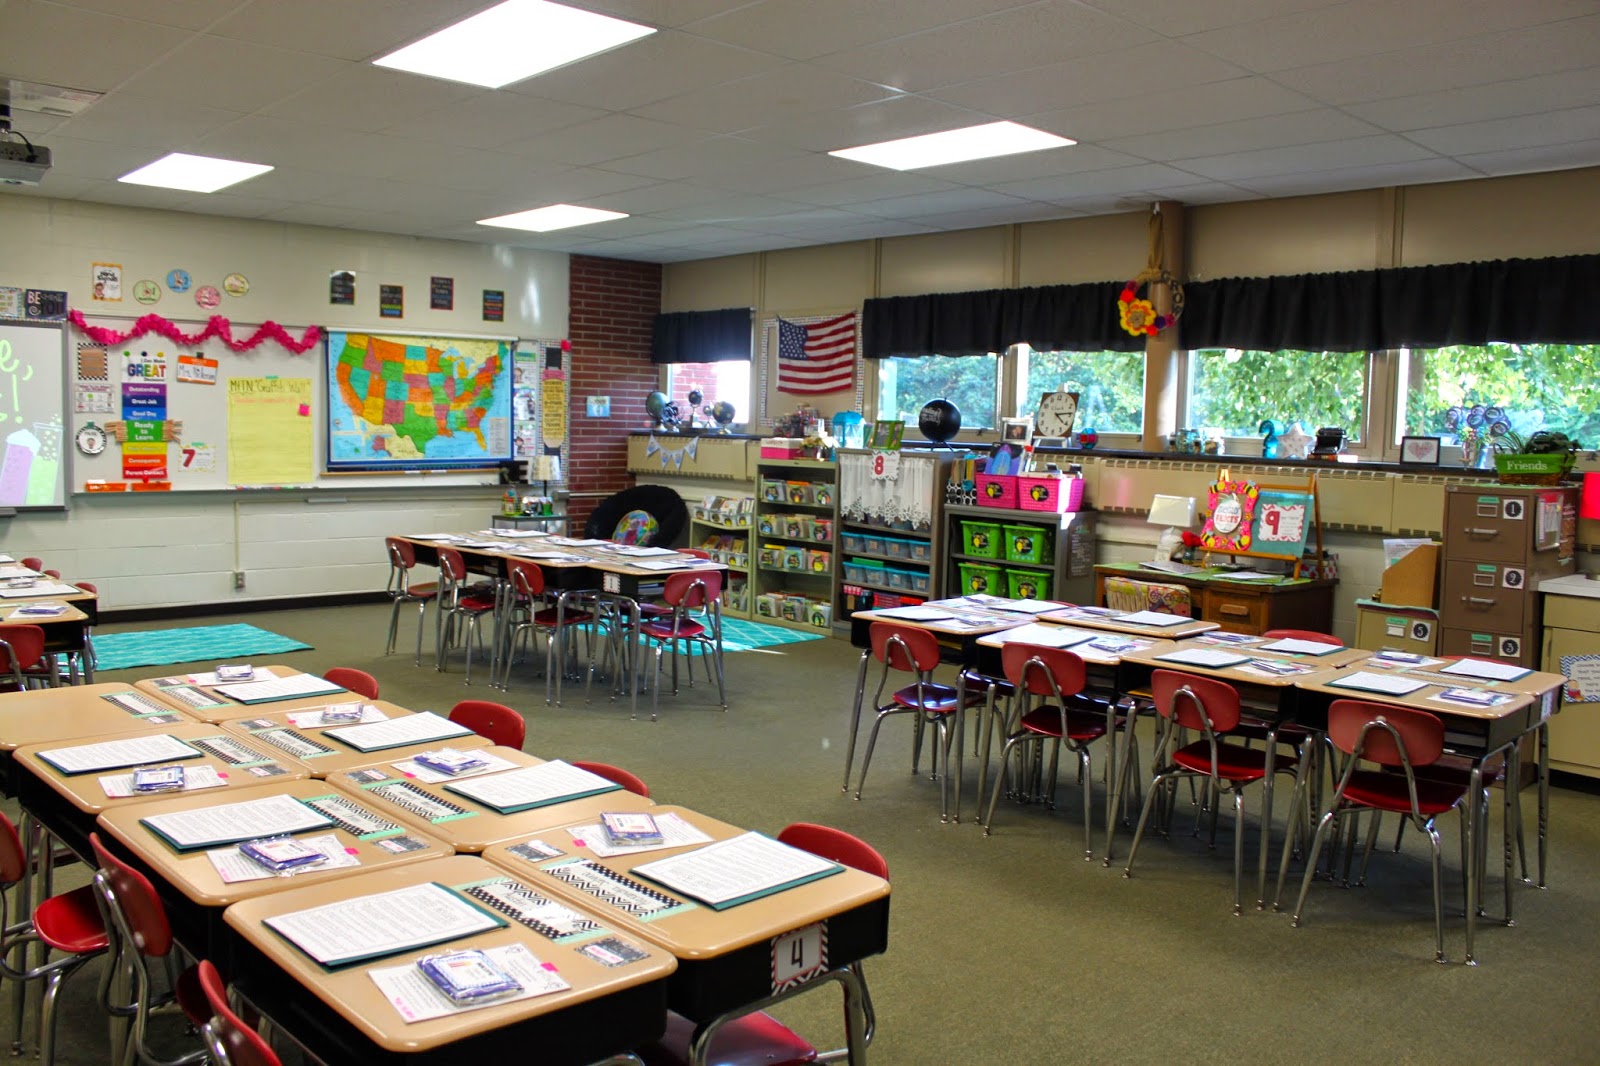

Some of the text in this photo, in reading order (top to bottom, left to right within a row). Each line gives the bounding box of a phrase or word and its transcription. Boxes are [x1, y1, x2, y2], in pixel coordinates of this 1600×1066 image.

[27, 291, 41, 304] BE
[127, 363, 166, 378] GREAT
[182, 449, 196, 468] 7
[874, 455, 884, 475] 8
[1506, 460, 1548, 471] Friends
[1511, 504, 1515, 514] 1
[1265, 511, 1280, 535] 9
[1510, 572, 1517, 583] 2
[1416, 627, 1424, 636] 5
[1507, 642, 1514, 652] 3
[791, 937, 803, 968] 4
